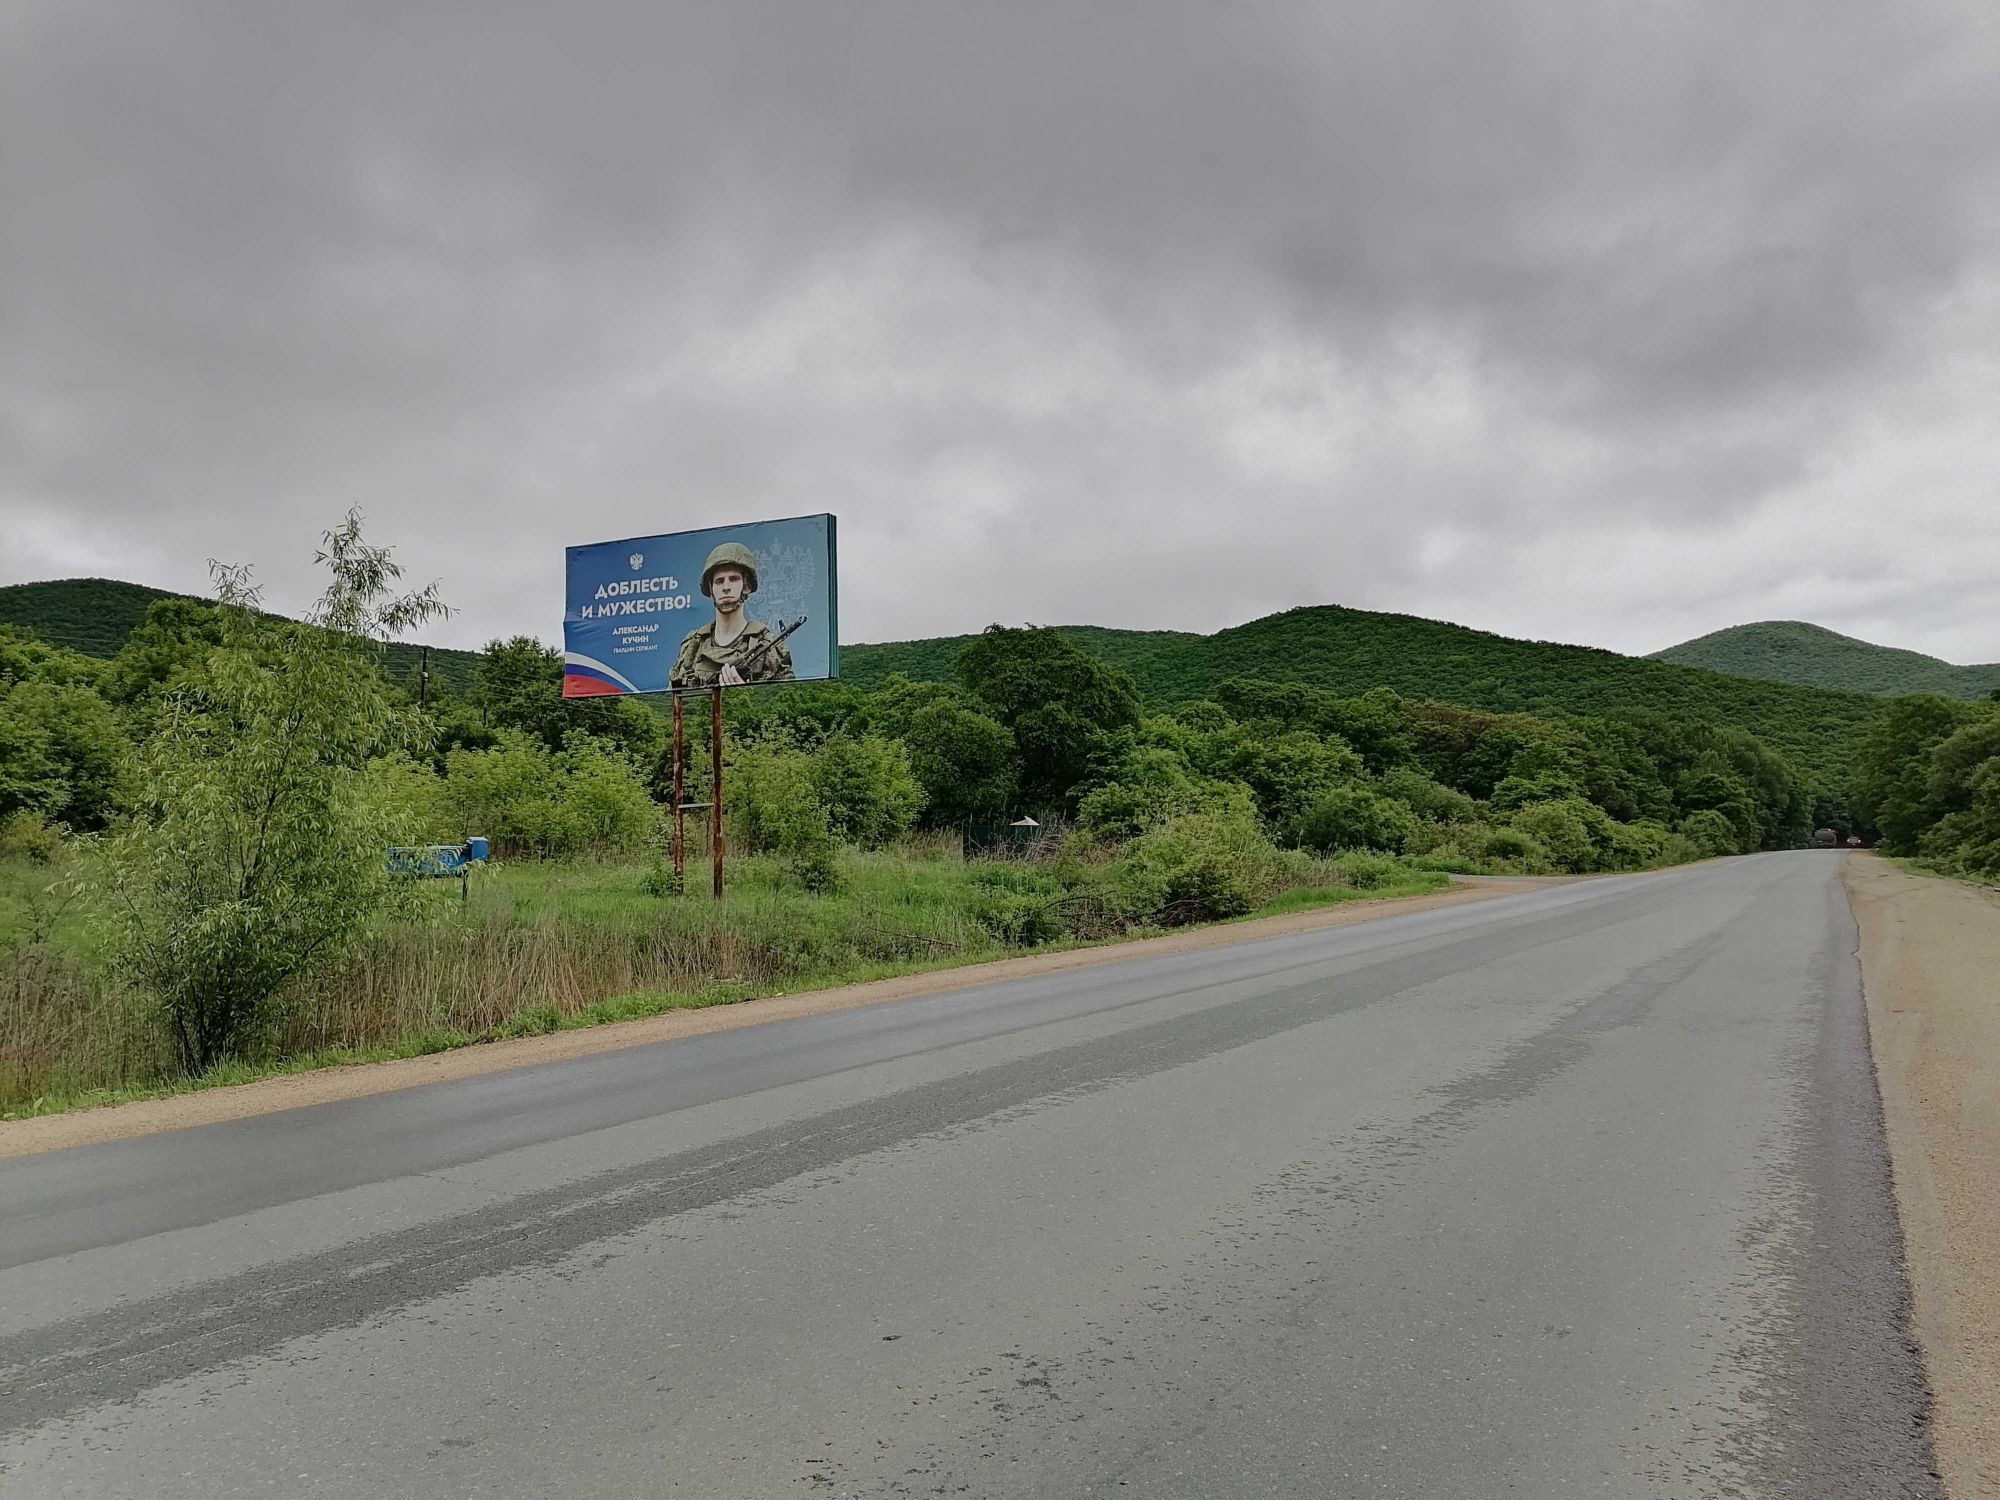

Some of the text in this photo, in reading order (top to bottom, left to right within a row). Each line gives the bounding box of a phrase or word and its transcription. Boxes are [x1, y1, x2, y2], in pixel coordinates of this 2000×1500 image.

[595, 576, 679, 599] ДОБЛЕСТЬ
[581, 595, 691, 619] И МУЖЕСТВО!
[612, 624, 659, 635] АЛЕКСАНДР
[622, 635, 649, 645] КУЧИН
[635, 644, 658, 653] СЕРЖАНТ
